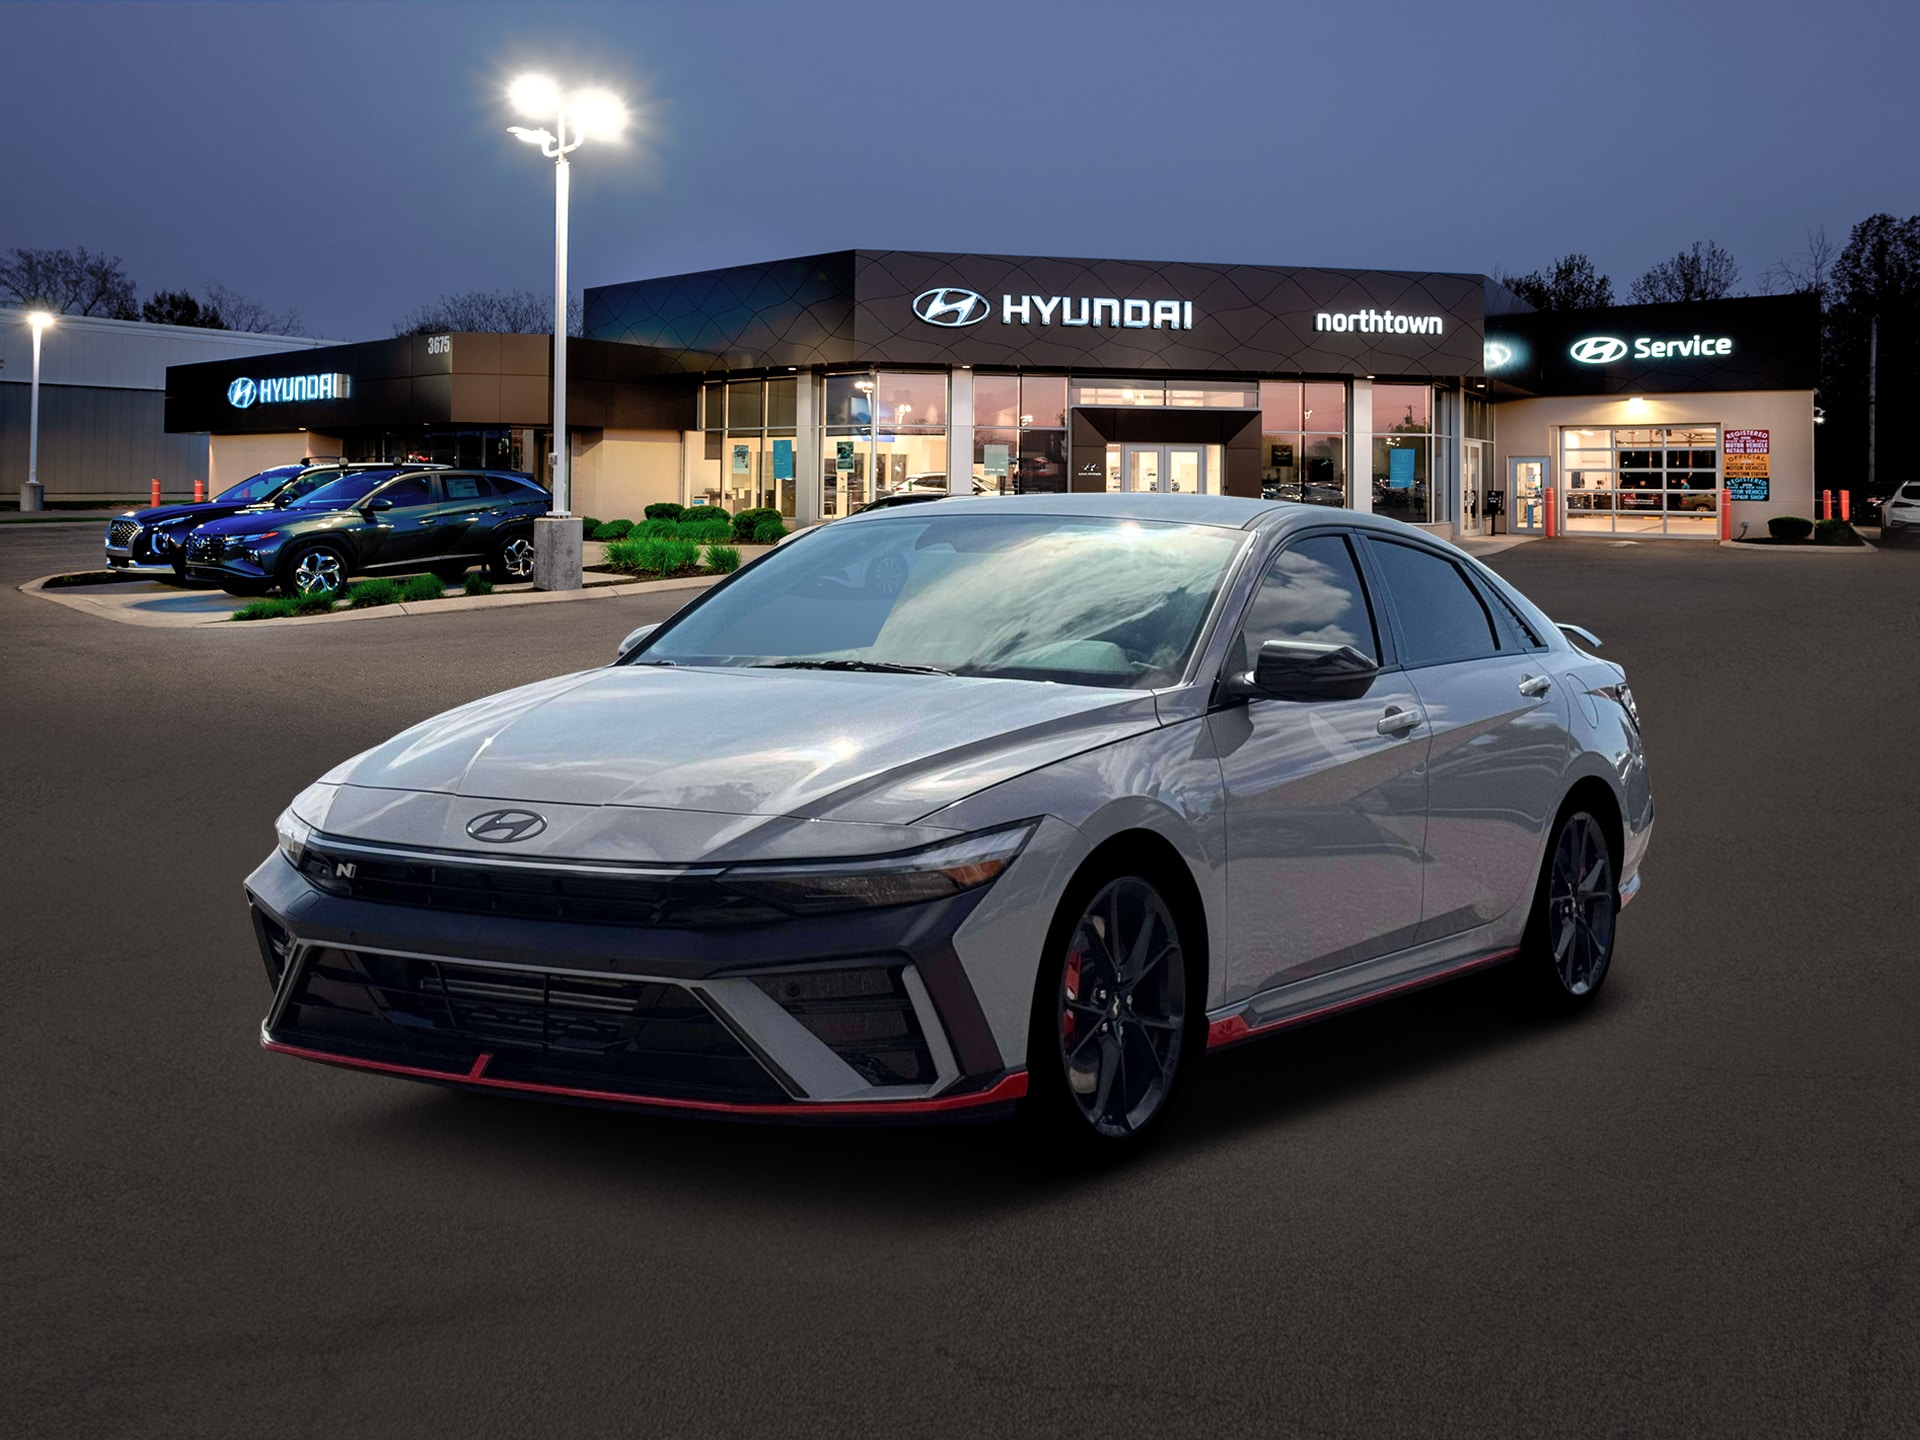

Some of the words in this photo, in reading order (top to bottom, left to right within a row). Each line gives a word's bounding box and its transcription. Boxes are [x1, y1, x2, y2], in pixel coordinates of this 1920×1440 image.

[1002, 294, 1193, 330] HYUNDAI
[1316, 309, 1443, 335] northtown
[428, 335, 450, 354] 3675
[1633, 335, 1732, 359] Service
[259, 373, 342, 403] HYUNDAI
[1726, 430, 1768, 439] REGISTERED
[1726, 478, 1767, 486] REGISTERED
